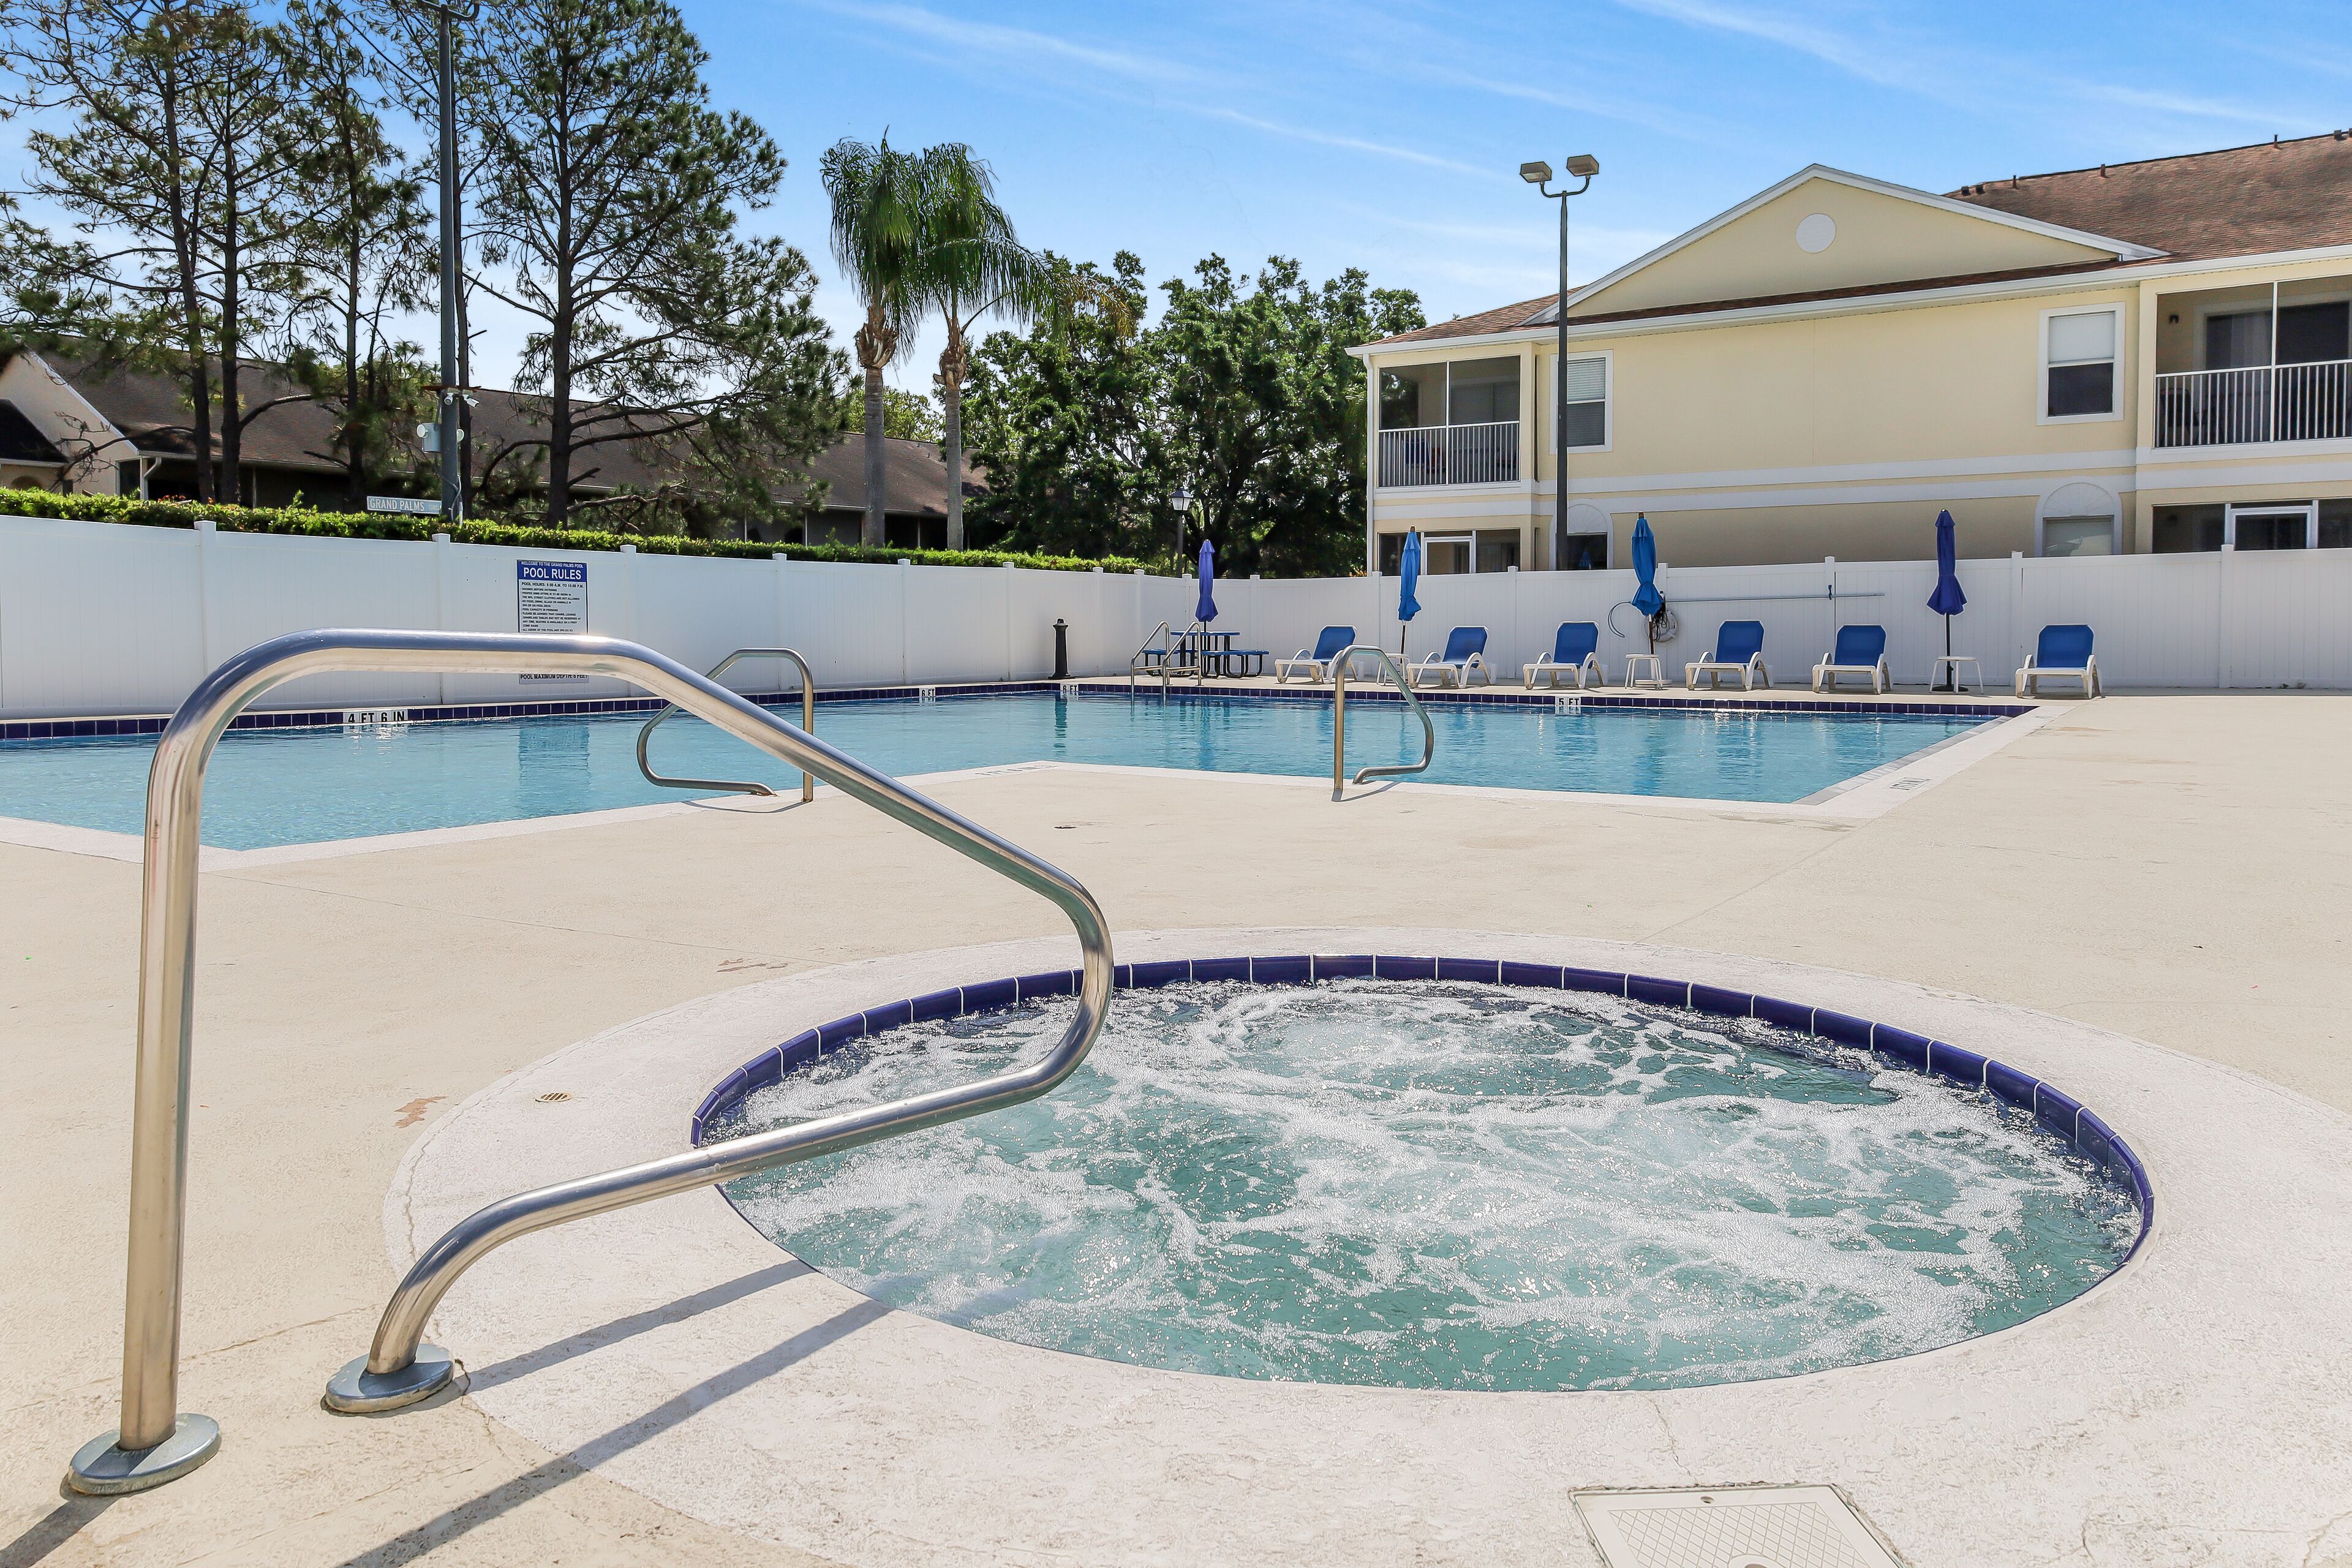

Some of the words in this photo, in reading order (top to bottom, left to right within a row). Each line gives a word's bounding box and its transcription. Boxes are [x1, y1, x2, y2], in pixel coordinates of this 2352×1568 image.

[370, 498, 397, 510] GRAND
[399, 500, 424, 511] PALMS
[524, 567, 549, 579] POOL
[552, 568, 581, 580] RULES
[348, 713, 356, 723] 4
[361, 712, 375, 723] FT
[381, 712, 388, 723] 6
[393, 710, 404, 722] IN
